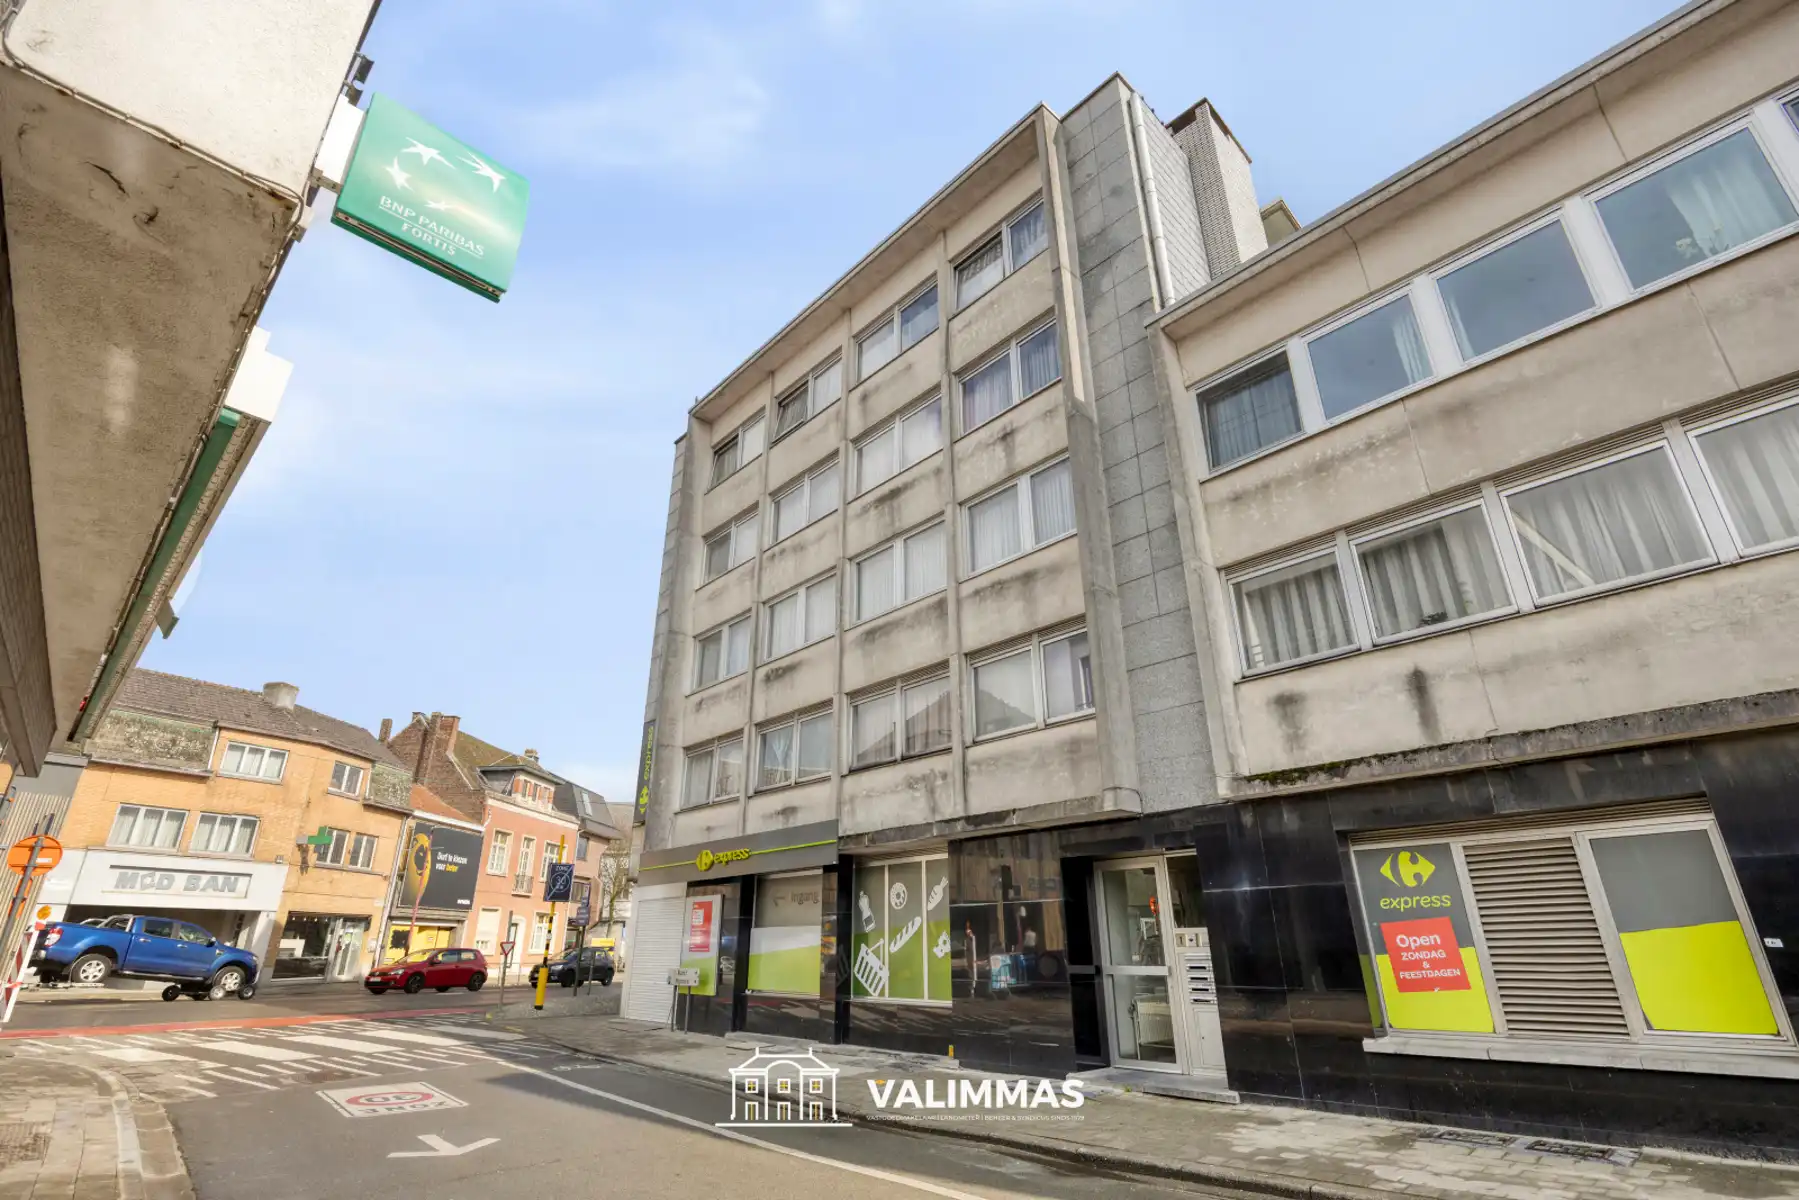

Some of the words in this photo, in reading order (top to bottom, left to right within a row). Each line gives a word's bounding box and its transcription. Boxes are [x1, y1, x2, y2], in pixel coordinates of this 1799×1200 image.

[380, 195, 416, 217] BNP
[419, 215, 484, 256] PARIBAS
[402, 222, 456, 256] FORTIS
[714, 848, 750, 866] express
[183, 874, 239, 892] BAN
[555, 875, 567, 885] 30
[1380, 894, 1452, 913] express
[1396, 934, 1441, 950] Open
[1401, 949, 1447, 961] ZONDAG
[1399, 968, 1461, 979] FEESTDAGEN
[1422, 961, 1431, 969] &
